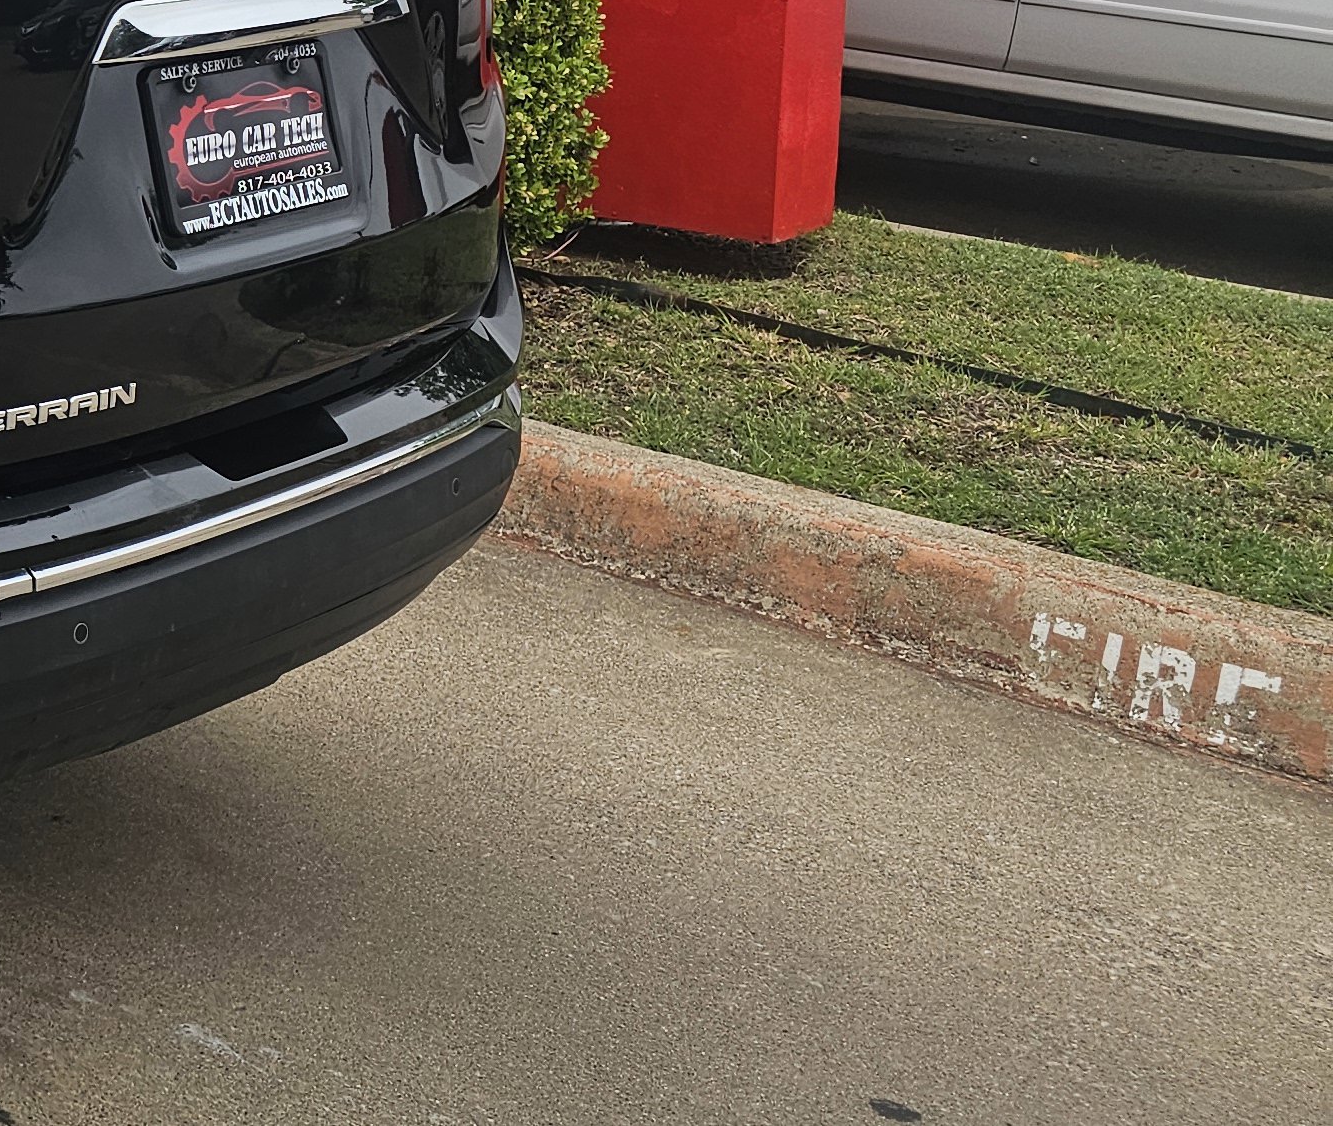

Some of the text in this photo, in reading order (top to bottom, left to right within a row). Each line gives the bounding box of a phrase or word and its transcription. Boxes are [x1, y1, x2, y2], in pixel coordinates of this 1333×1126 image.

[202, 56, 244, 73] SERVICE
[185, 112, 325, 167] EURO CAR TECH
[233, 139, 328, 169] european automotive
[237, 161, 333, 193] 817-404-4033
[183, 177, 349, 235] www.ECTAUTOSALES.com
